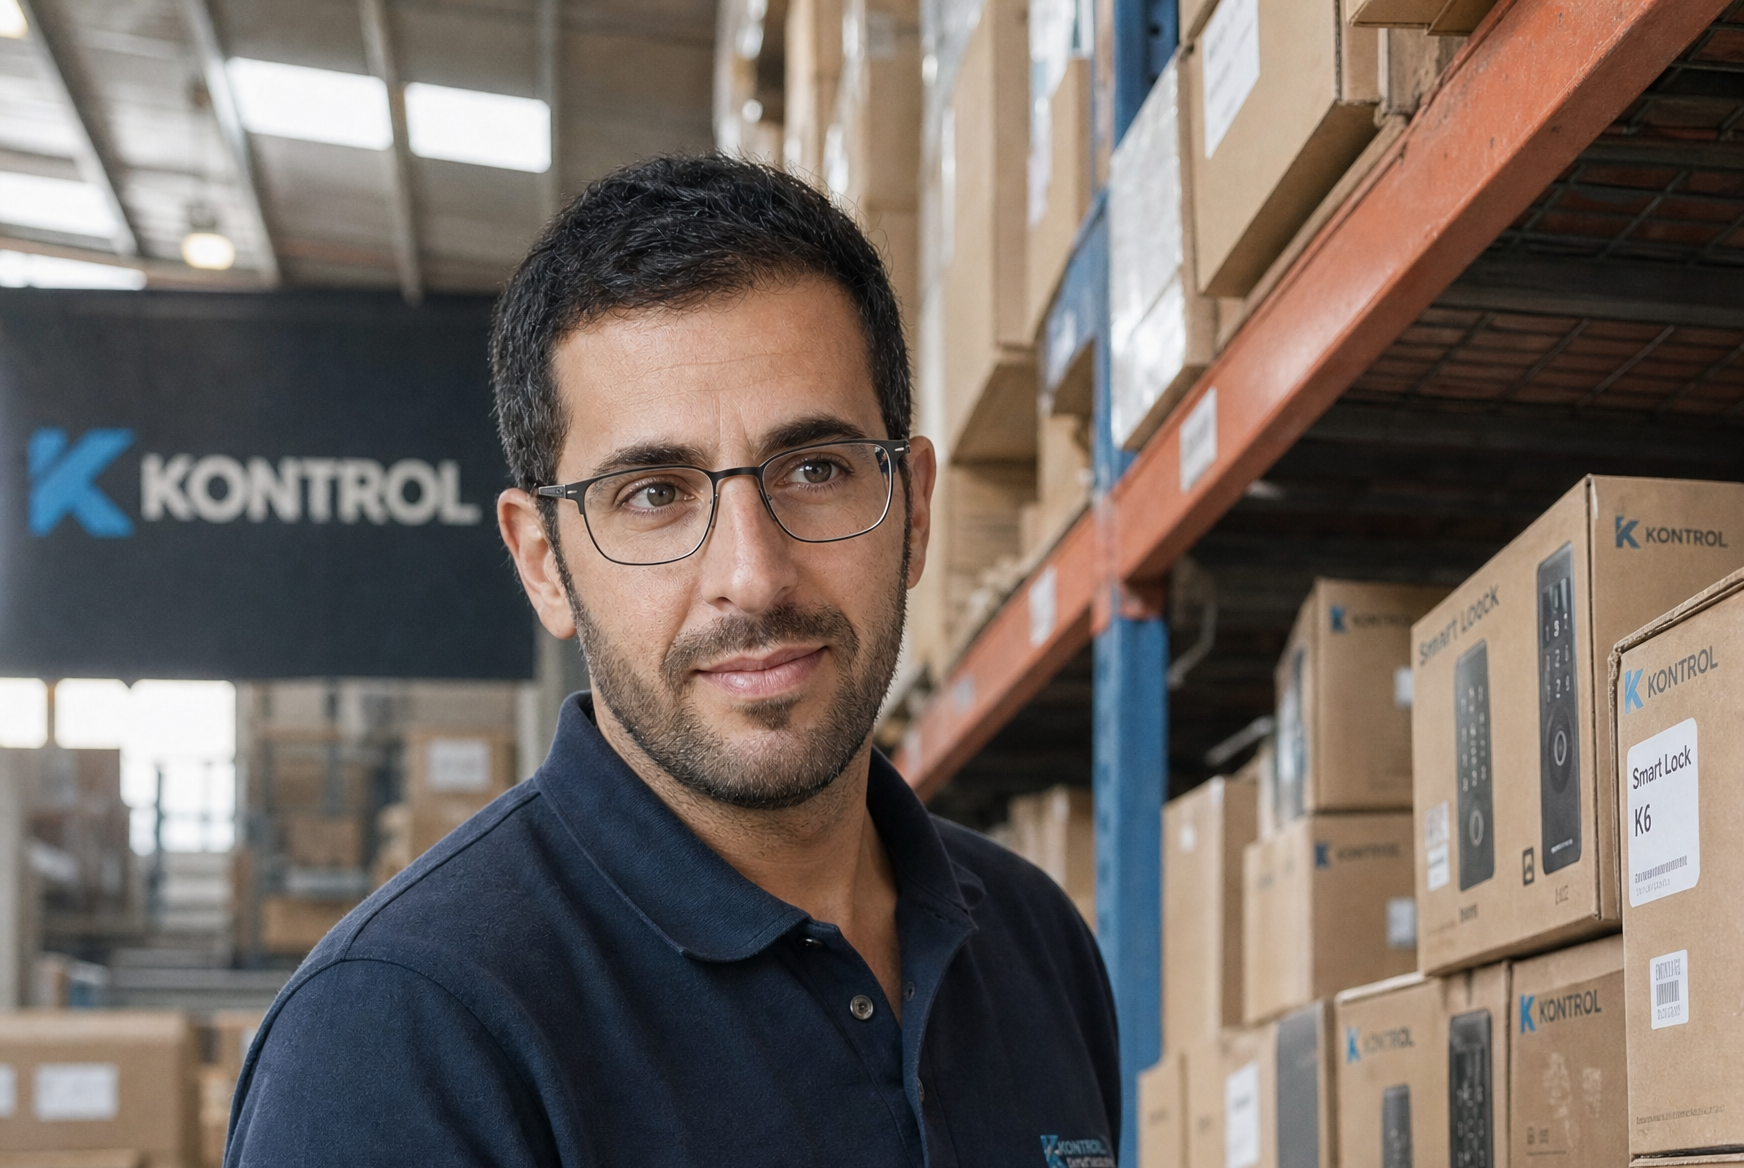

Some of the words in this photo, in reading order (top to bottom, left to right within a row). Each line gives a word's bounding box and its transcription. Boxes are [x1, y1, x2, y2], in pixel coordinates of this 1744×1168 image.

[27, 427, 136, 537] K
[140, 454, 482, 525] KONTROL
[1615, 515, 1640, 549] K
[1645, 526, 1729, 549] KONTROL
[1624, 668, 1644, 715] K
[1647, 645, 1719, 699] KONTROL
[1632, 757, 1662, 790] Smart
[1664, 744, 1692, 775] Lock
[1633, 803, 1652, 837] K6
[1538, 989, 1602, 1024] KONTROL
